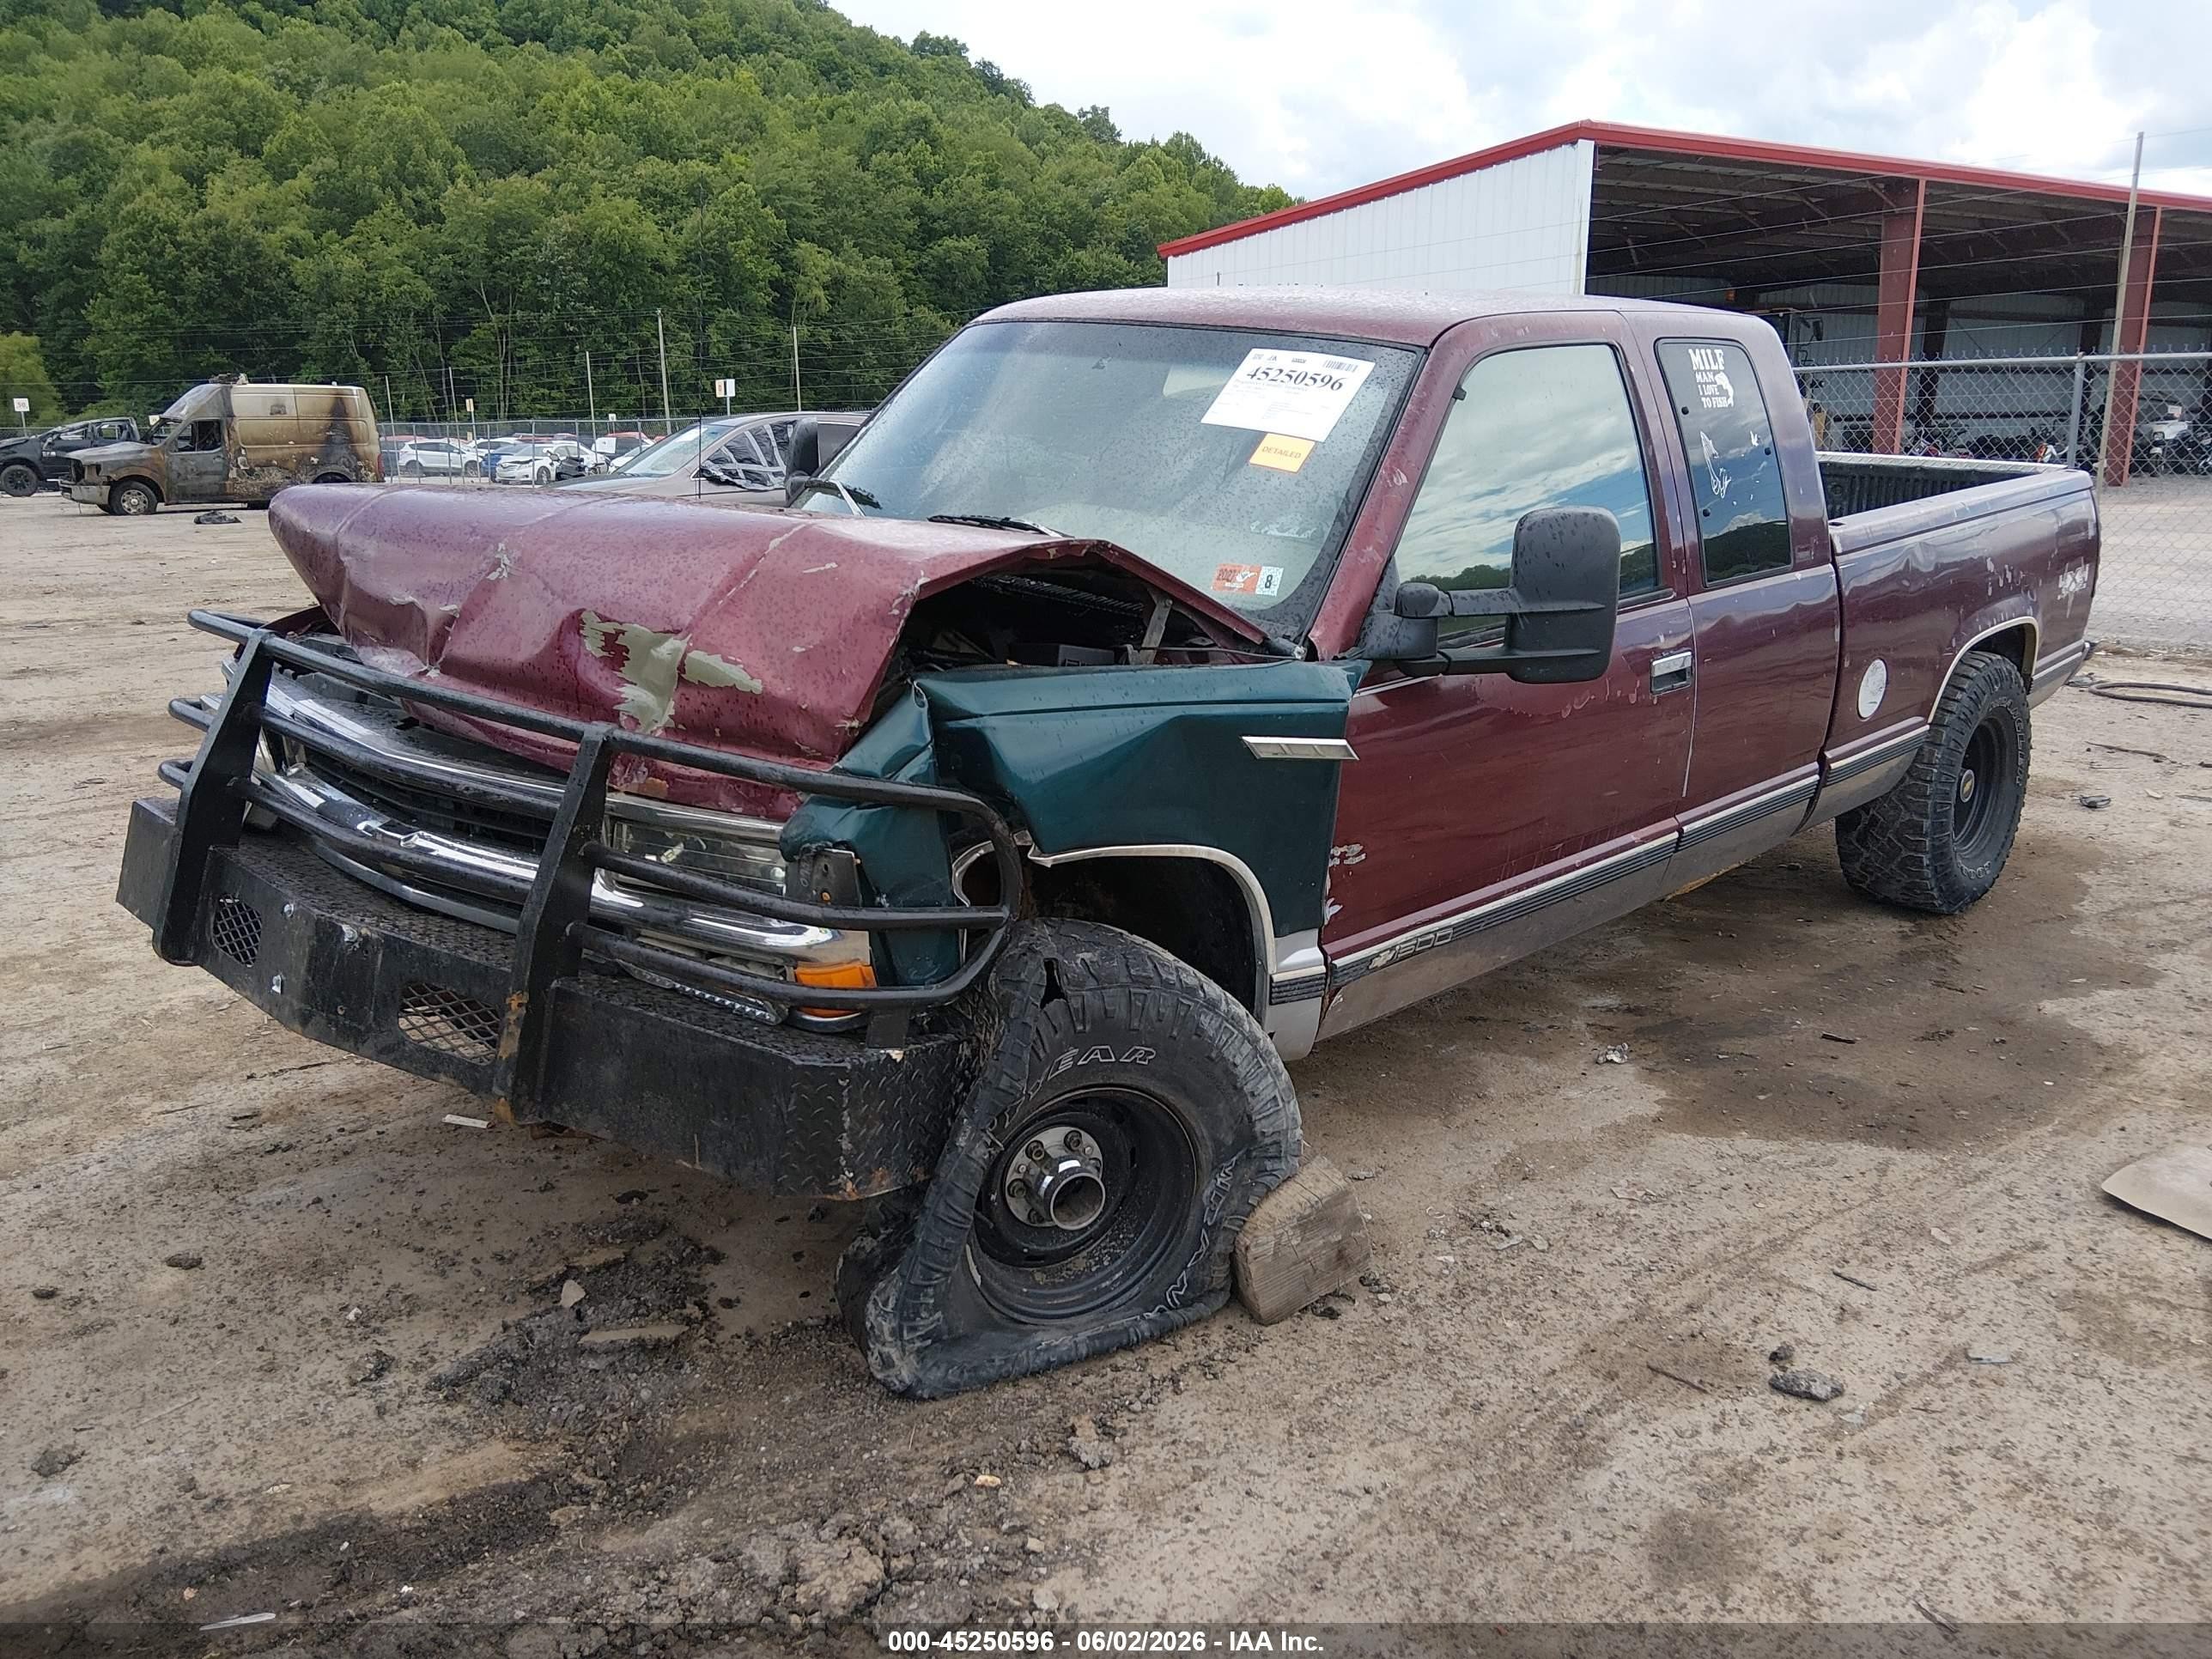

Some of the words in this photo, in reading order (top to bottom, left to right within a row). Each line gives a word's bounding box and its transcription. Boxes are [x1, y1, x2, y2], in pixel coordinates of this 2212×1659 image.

[1688, 349, 1725, 370] MILF
[1247, 367, 1346, 391] 45250596
[1695, 371, 1715, 383] MAN
[1698, 385, 1703, 396] I
[1703, 384, 1720, 396] LOVE
[1701, 397, 1711, 408] TO
[1711, 396, 1728, 408] FISH
[1261, 445, 1303, 459] DETAILED
[1265, 574, 1273, 588] 8
[1392, 928, 1453, 961] 1500
